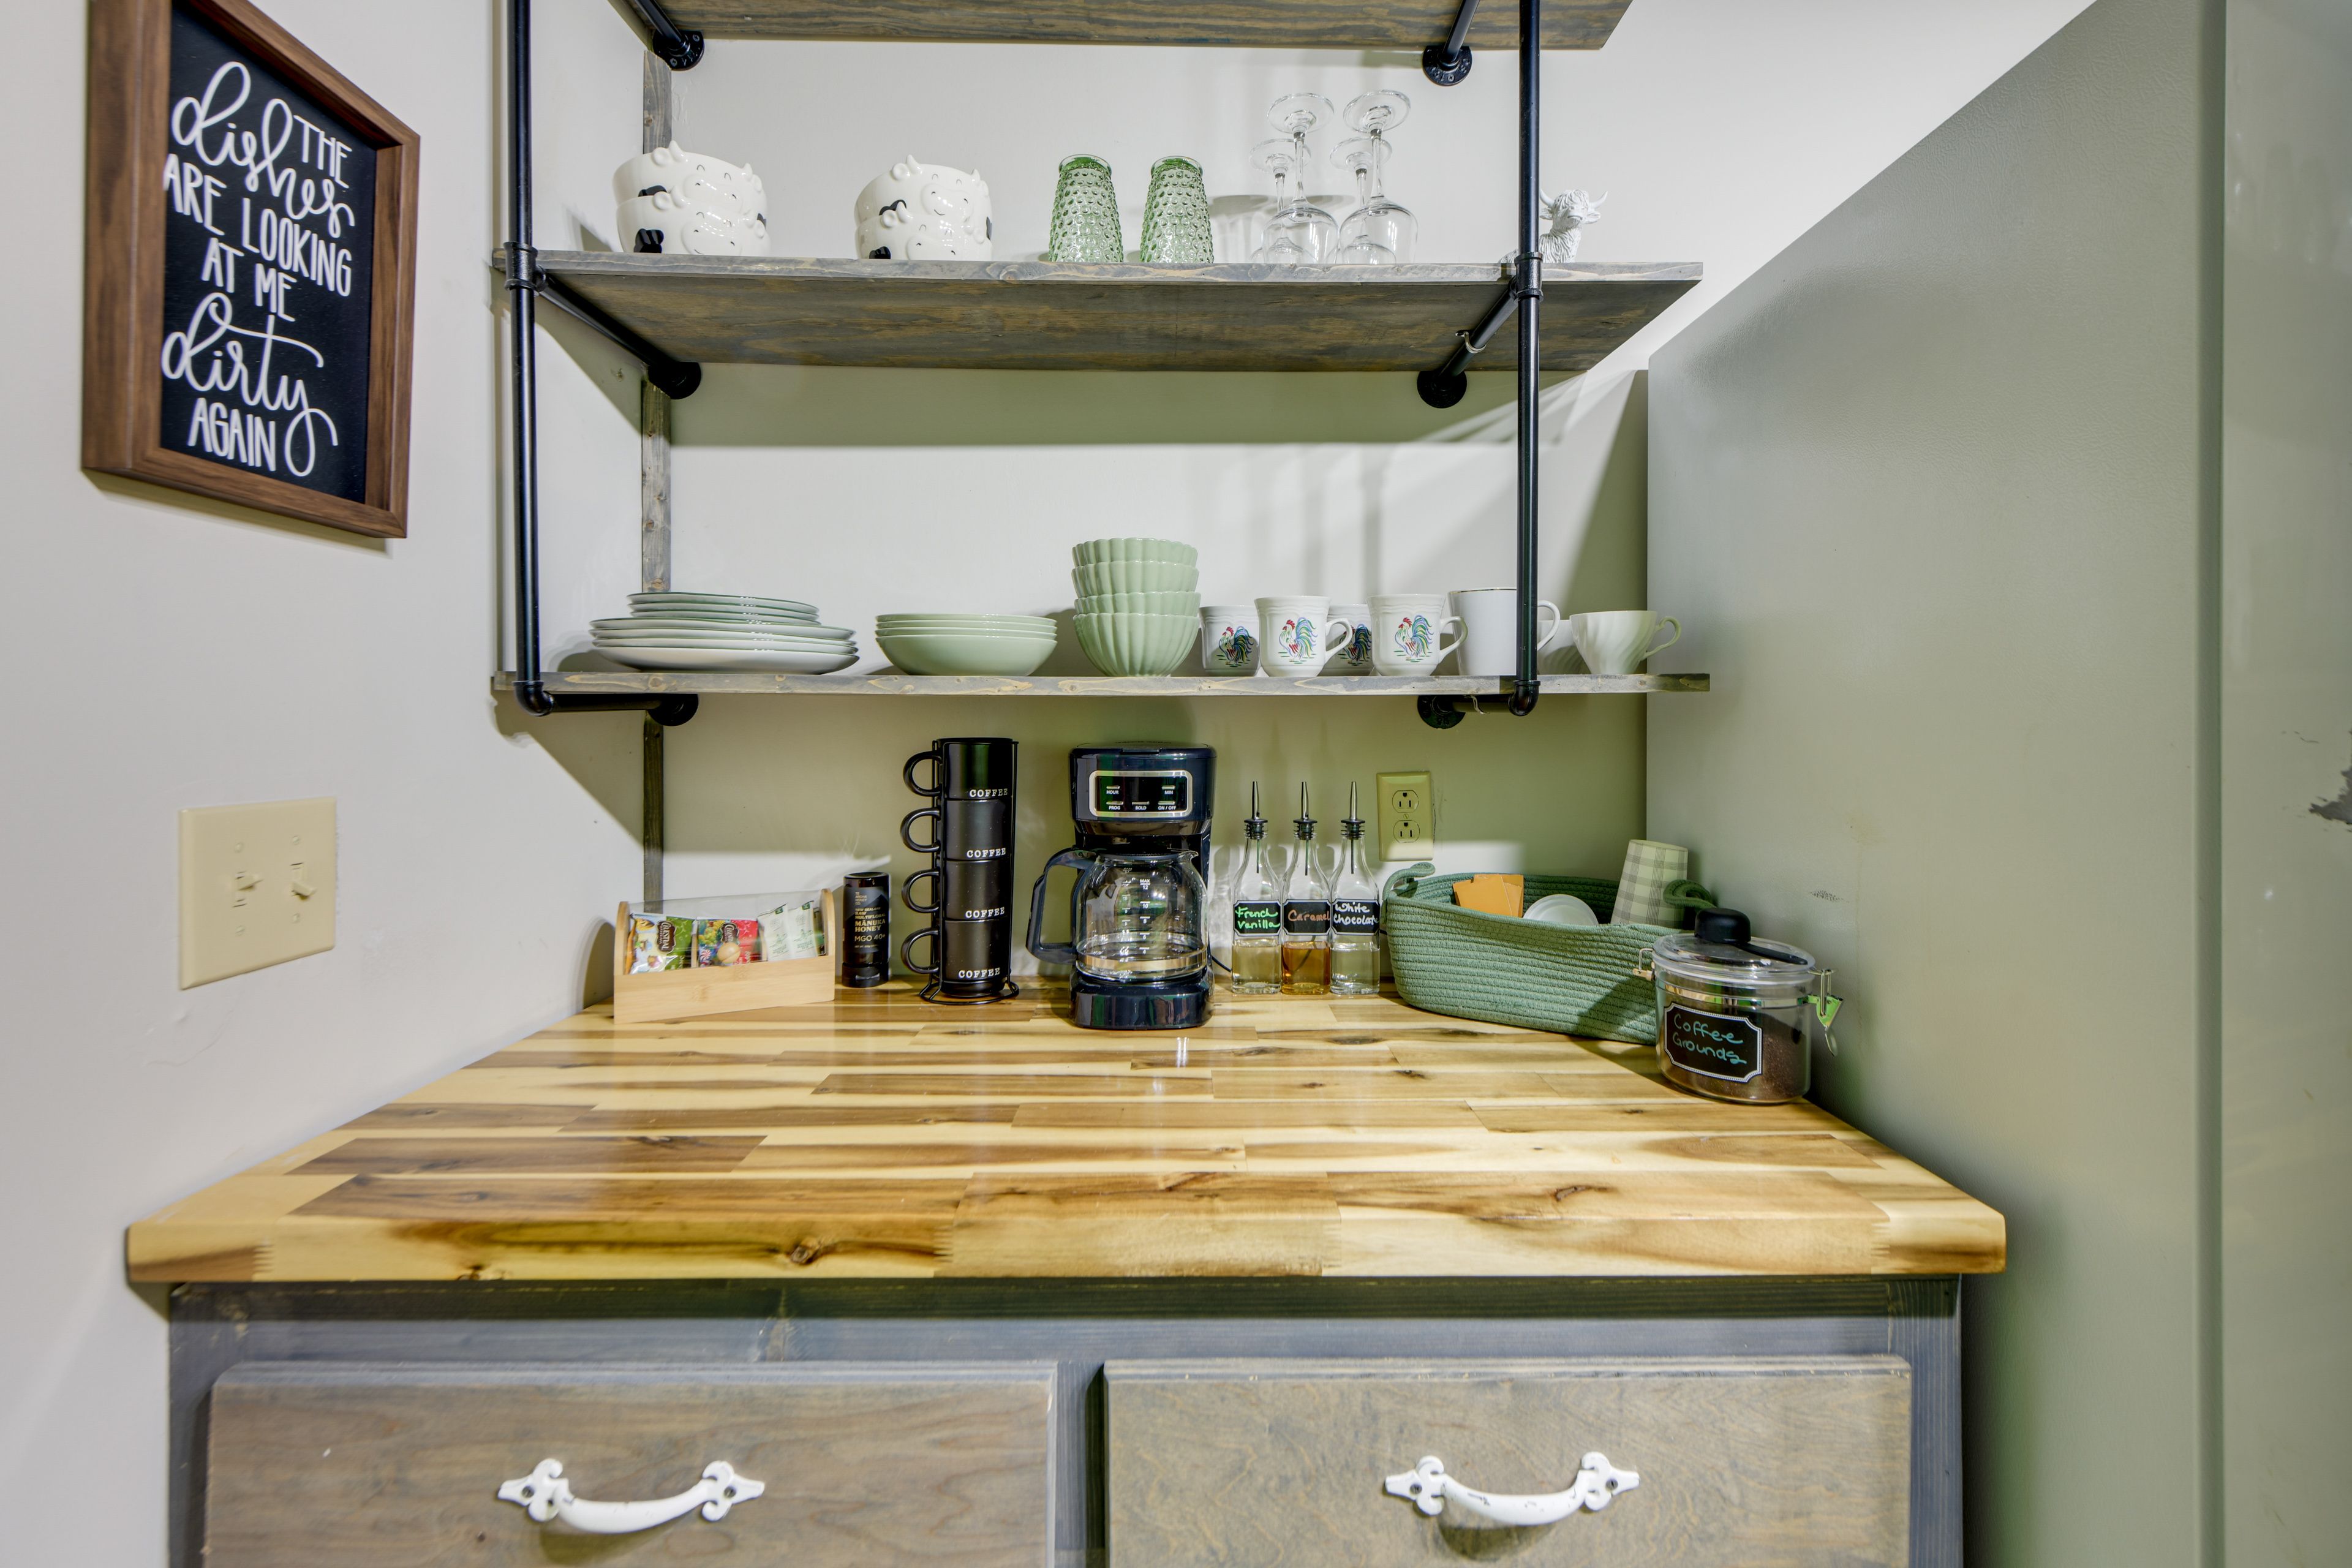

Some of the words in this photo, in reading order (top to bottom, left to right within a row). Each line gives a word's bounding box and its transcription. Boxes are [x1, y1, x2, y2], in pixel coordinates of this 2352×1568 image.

[172, 61, 355, 238] dishes
[293, 115, 352, 189] THE
[163, 153, 227, 236] ARE
[243, 197, 353, 296] LOOKING
[201, 237, 245, 293] AT
[254, 263, 297, 322] ME
[160, 292, 339, 477] dirty
[187, 397, 276, 472] AGAIN
[969, 788, 1008, 797] COFFEE
[966, 847, 1006, 858] COFFEE
[965, 907, 1005, 919] COFFEE
[1235, 906, 1279, 919] French
[1287, 910, 1330, 922] Caramel
[1334, 901, 1370, 913] White
[958, 967, 1001, 979] COFFEE
[1673, 1013, 1743, 1044] Coffee
[1672, 1031, 1747, 1065] Grounds
